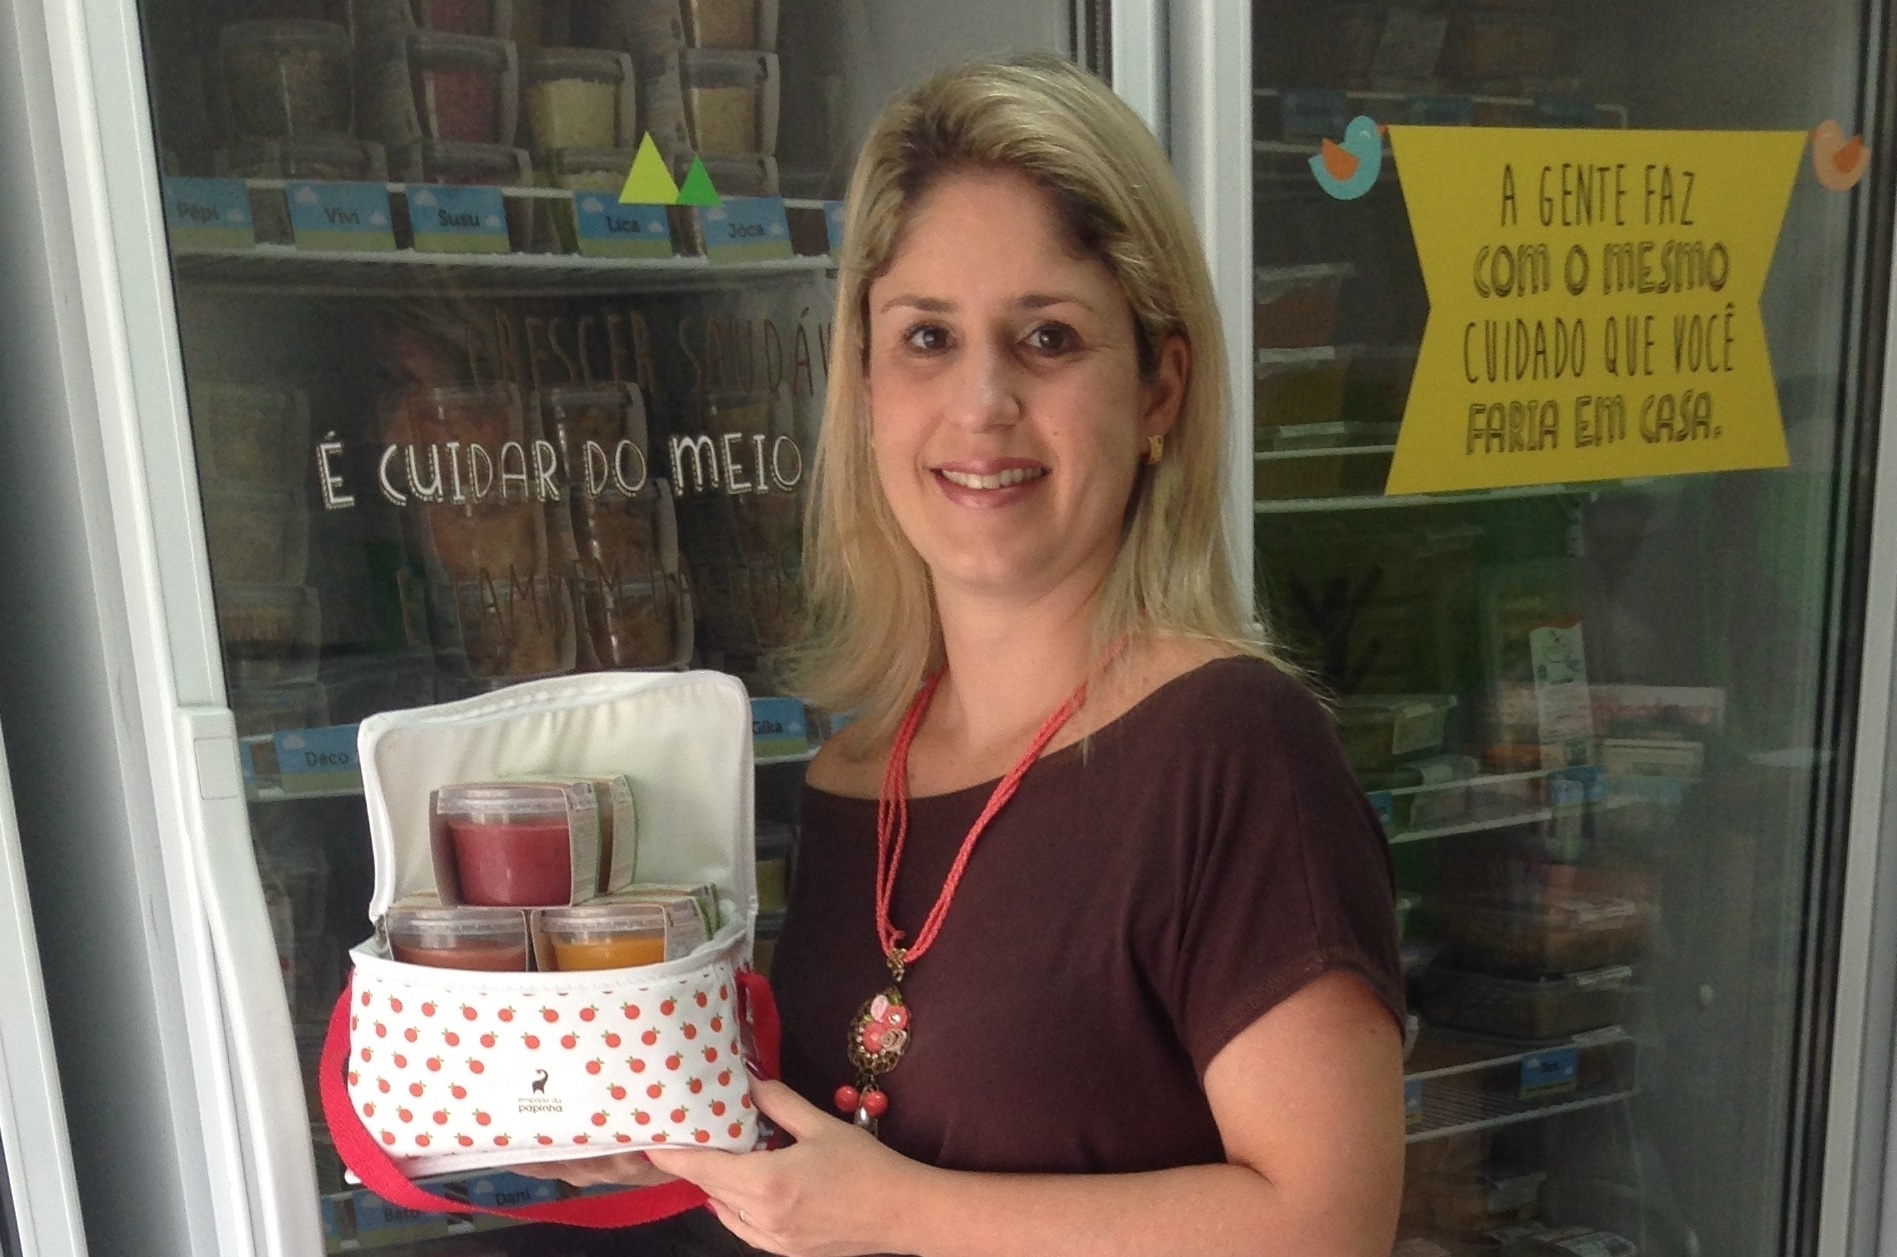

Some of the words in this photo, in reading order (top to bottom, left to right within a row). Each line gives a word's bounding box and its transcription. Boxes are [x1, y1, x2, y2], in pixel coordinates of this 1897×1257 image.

[1501, 163, 1518, 228] A
[1539, 165, 1627, 227] GENTE
[1644, 164, 1696, 227] FAZ
[1473, 243, 1553, 298] COM
[1564, 244, 1590, 295] O
[1602, 240, 1730, 295] MESMO
[1463, 317, 1587, 383] CUIDADO
[1605, 314, 1655, 378] QUE
[1673, 302, 1736, 373] VOCÊ
[1467, 399, 1559, 456] FARIA
[1574, 394, 1627, 448] EM
[1639, 389, 1722, 444] CASA.
[316, 430, 354, 510] É
[379, 440, 560, 506] CUIDAR
[584, 438, 648, 498] DO
[669, 432, 803, 498] MEIO
[518, 1104, 563, 1114] papinha
